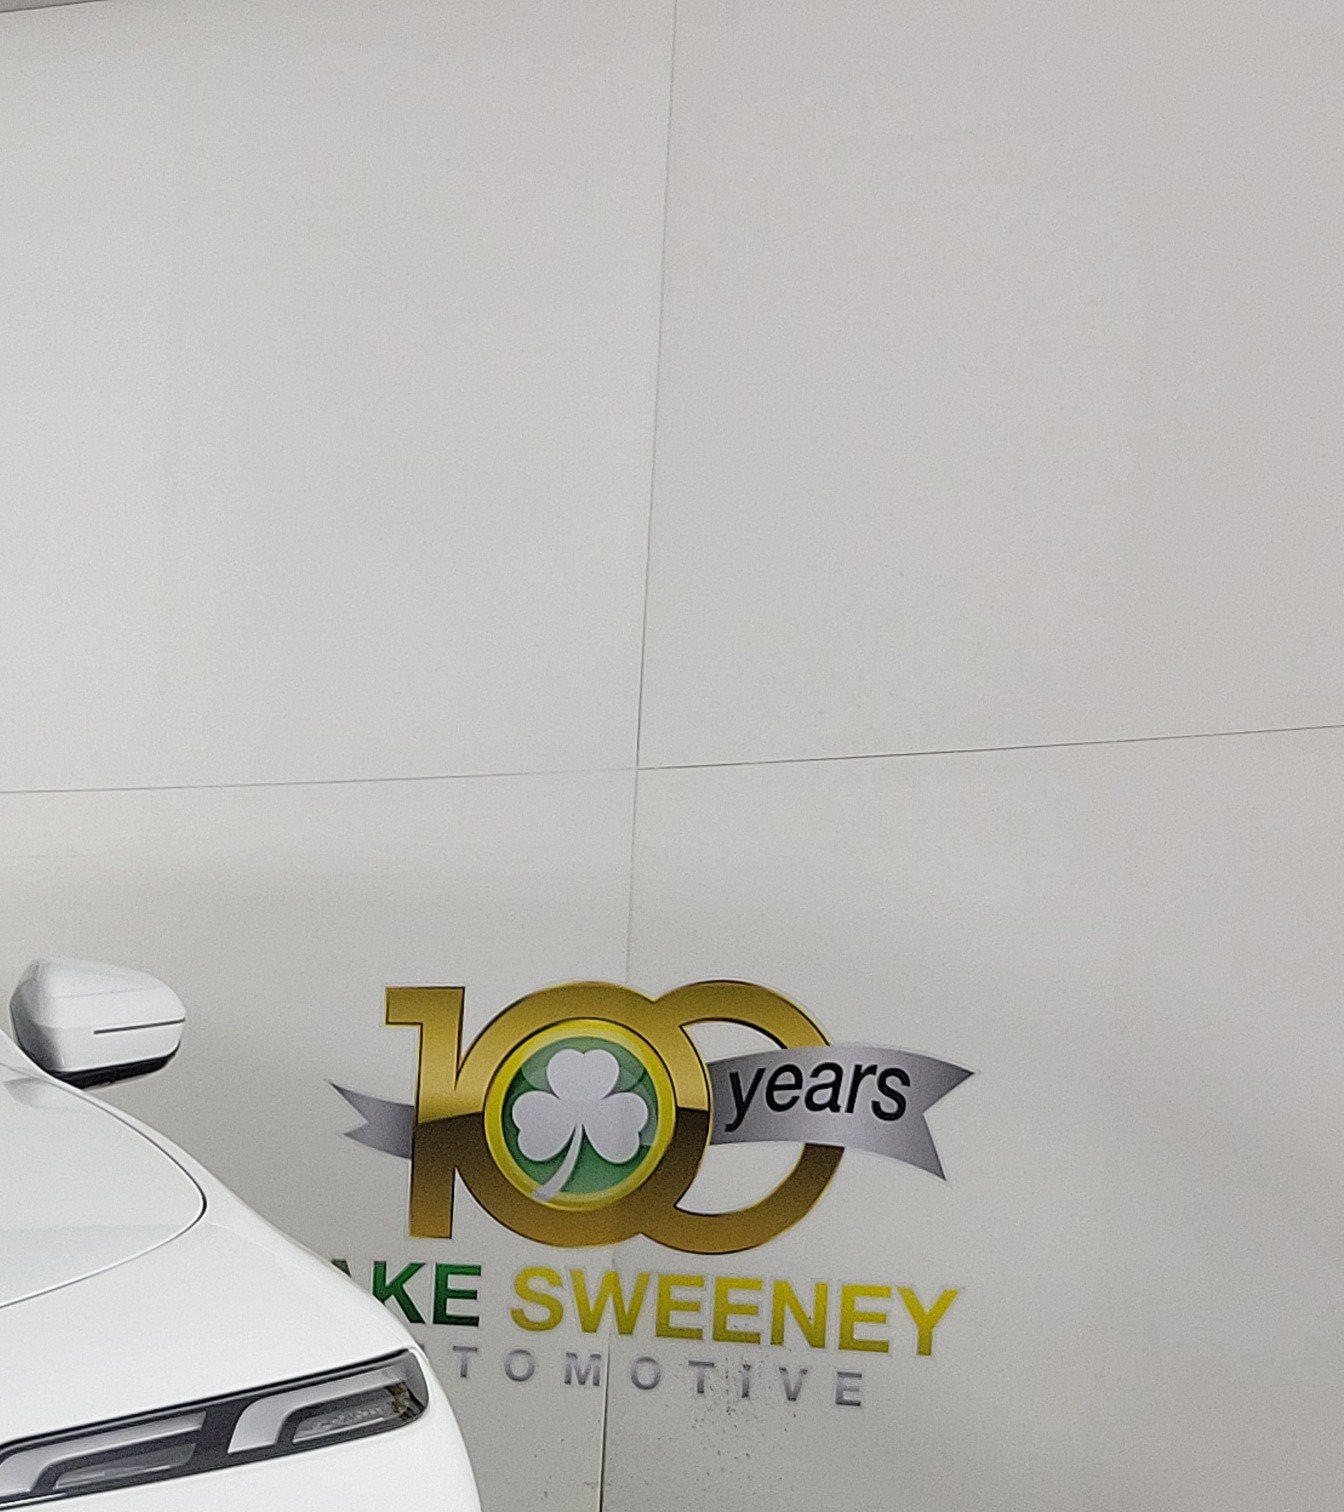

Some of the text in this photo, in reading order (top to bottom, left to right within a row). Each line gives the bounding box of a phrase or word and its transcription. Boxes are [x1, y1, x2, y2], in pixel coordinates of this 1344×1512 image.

[384, 979, 913, 1256] 100 years
[330, 1258, 959, 1357] KE SWEENEY
[417, 1343, 864, 1408] TOMOTIVE
